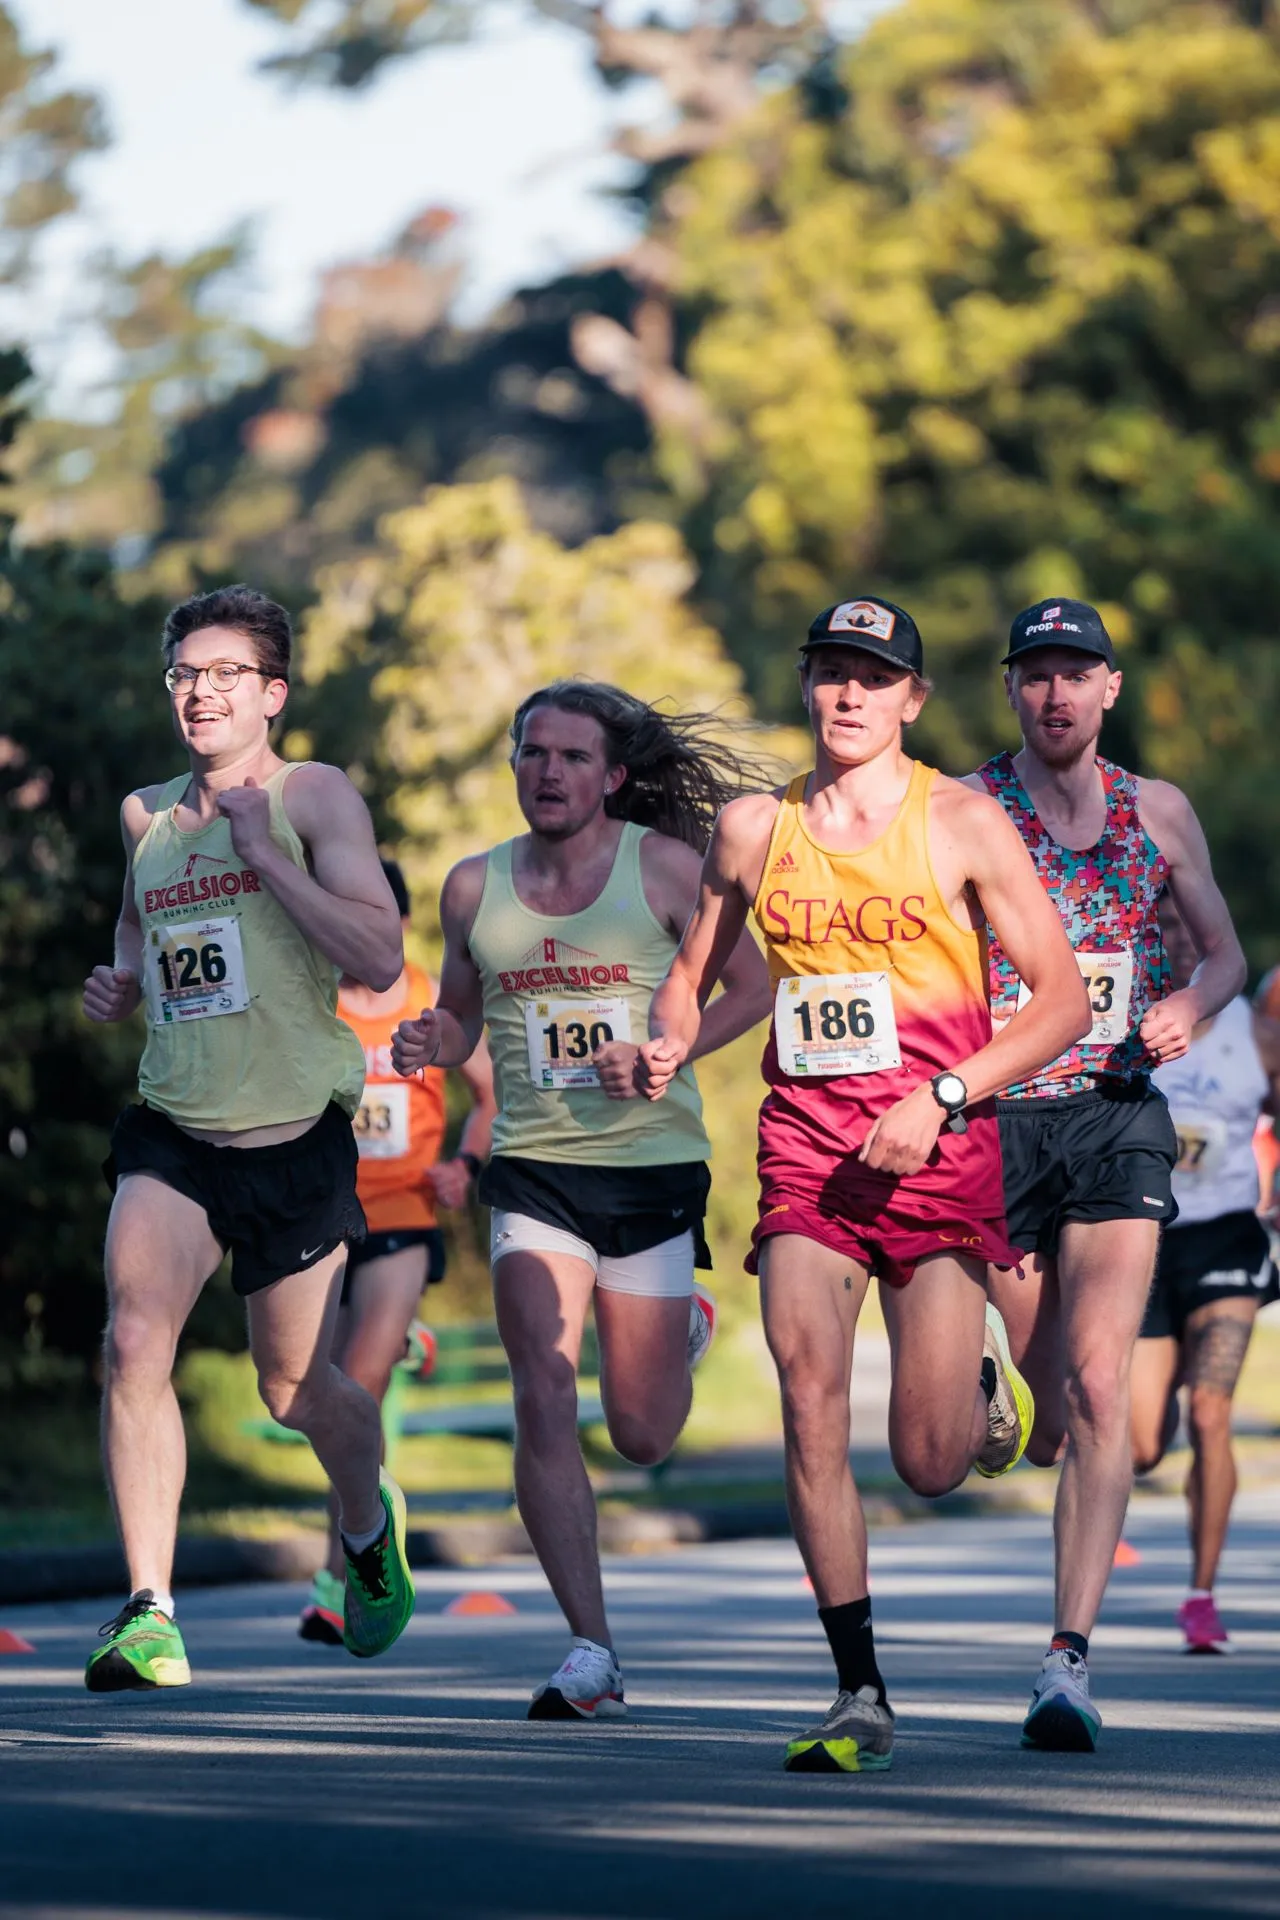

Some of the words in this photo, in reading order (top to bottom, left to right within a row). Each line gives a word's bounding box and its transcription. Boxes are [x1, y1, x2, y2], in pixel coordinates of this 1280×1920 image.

[144, 870, 262, 914] EXCELSIOR
[163, 902, 205, 919] RUNNING
[209, 898, 236, 911] CLUB
[765, 889, 928, 944] STAGS
[157, 943, 227, 990] 126
[498, 964, 630, 993] EXCELSIOR
[543, 1021, 614, 1059] 130
[793, 998, 875, 1041] 186
